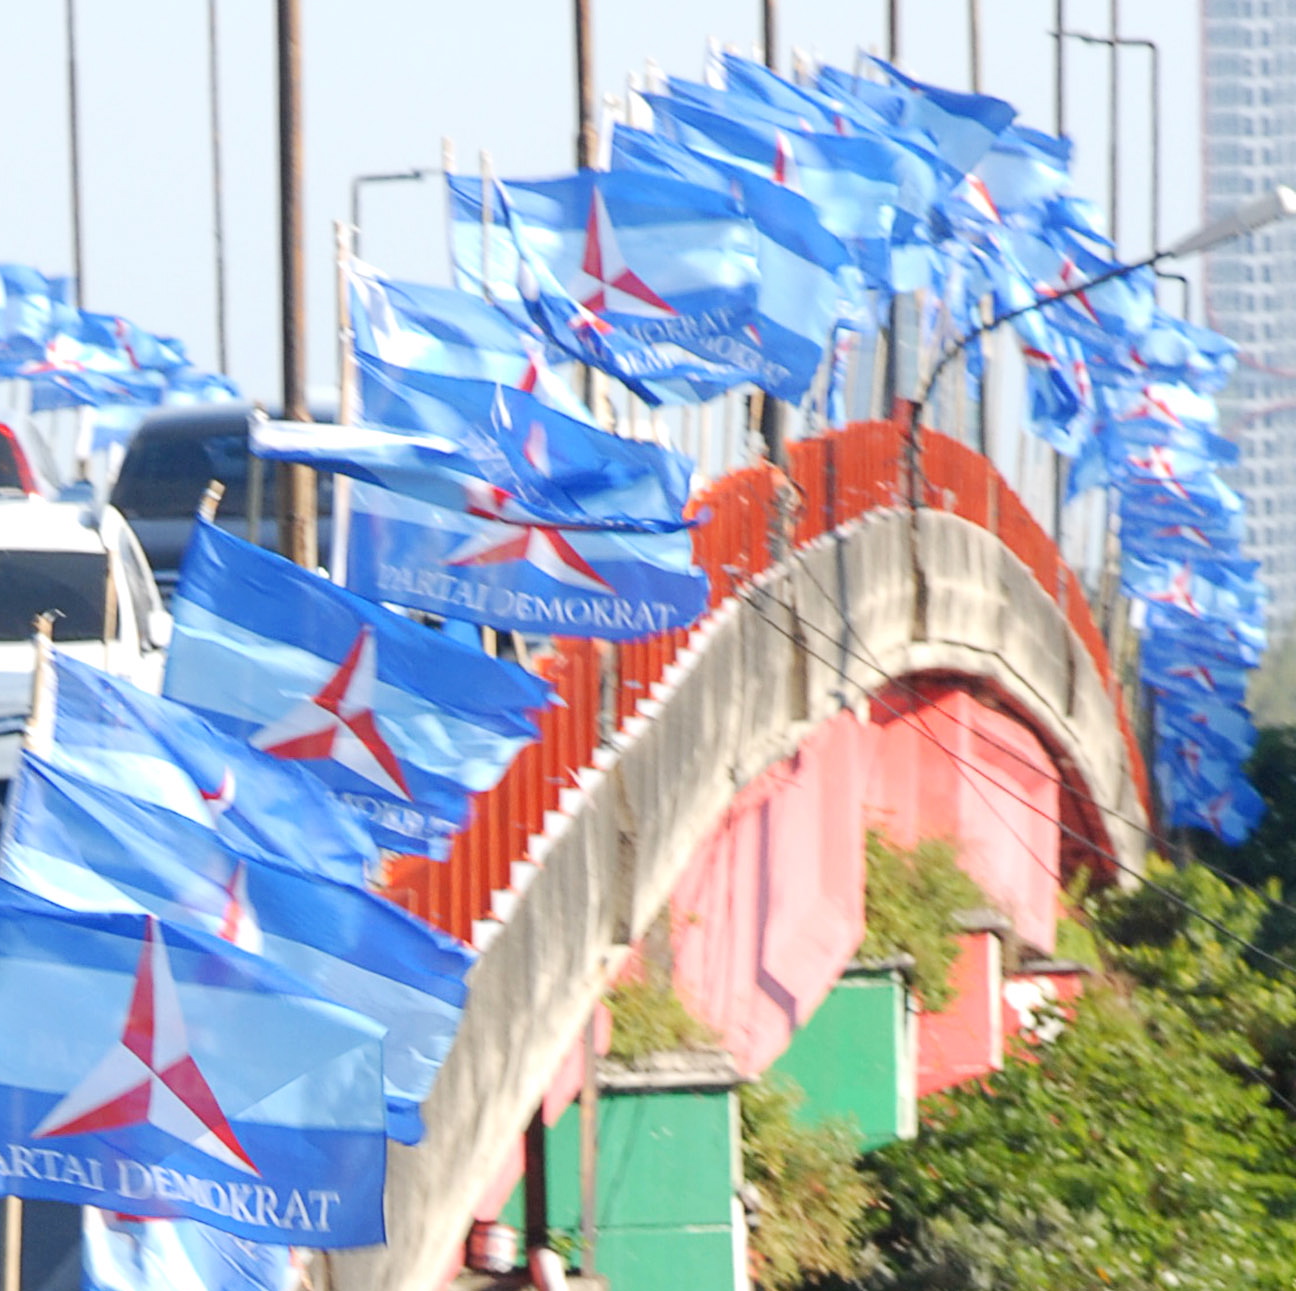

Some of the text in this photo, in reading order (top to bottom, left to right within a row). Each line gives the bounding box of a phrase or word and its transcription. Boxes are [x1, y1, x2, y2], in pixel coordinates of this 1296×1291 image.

[376, 564, 678, 632] PARTAI DEMOKRAT
[115, 1158, 341, 1233] DEMOKRAT
